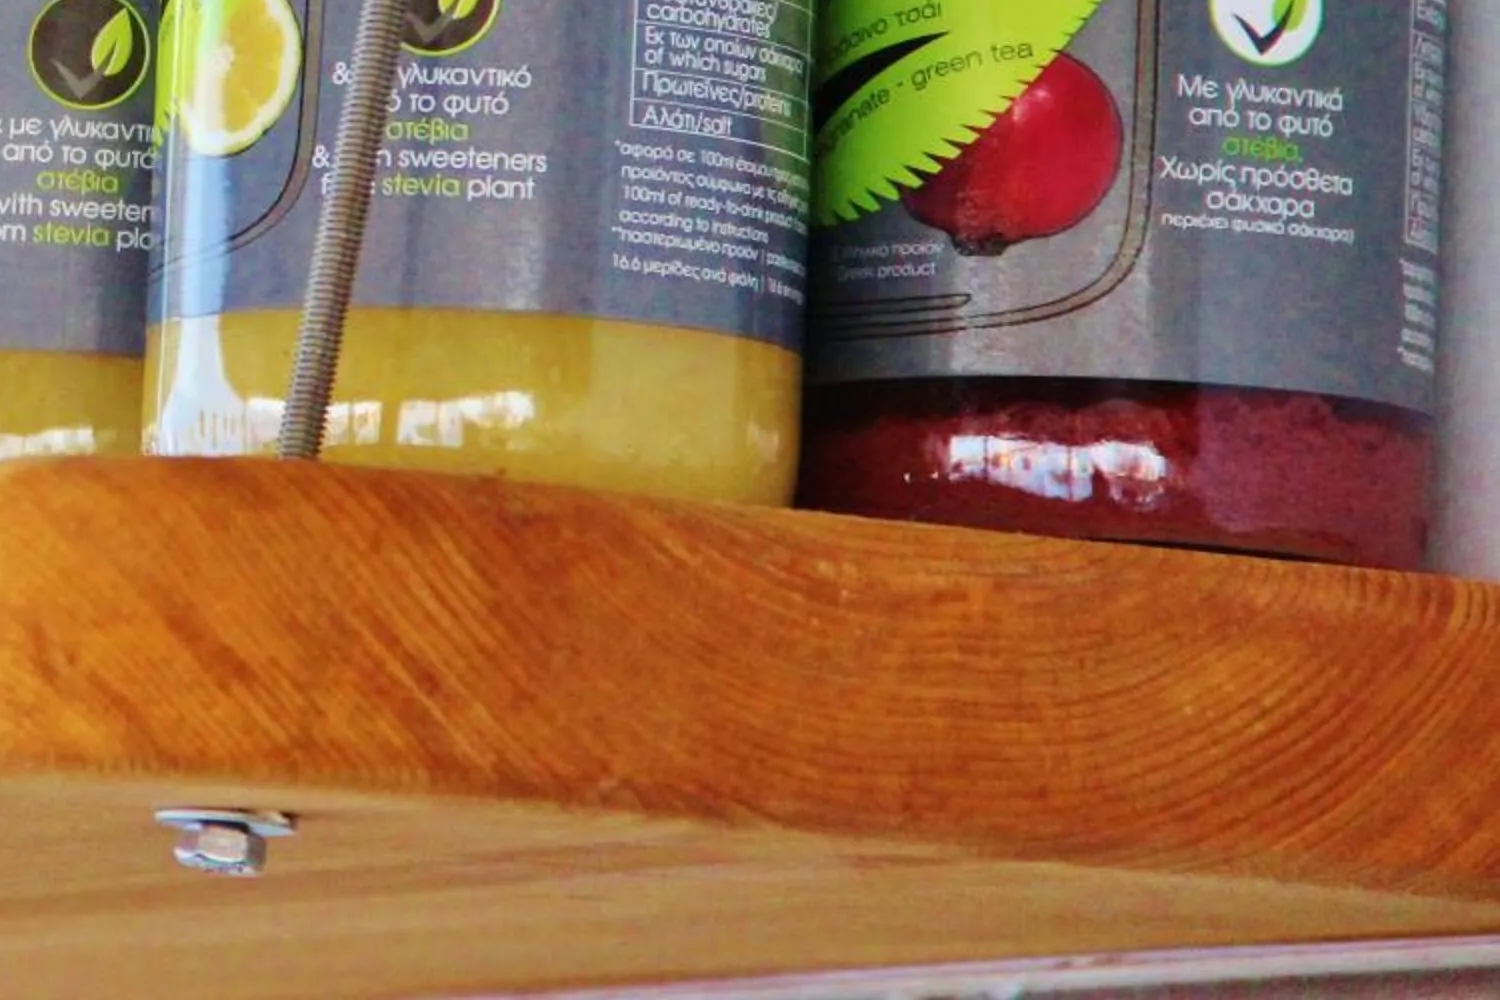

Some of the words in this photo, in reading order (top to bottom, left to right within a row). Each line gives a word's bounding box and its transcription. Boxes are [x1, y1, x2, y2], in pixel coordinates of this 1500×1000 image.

[646, 3, 770, 39] carbohydrates
[644, 48, 664, 66] of
[669, 52, 721, 73] which
[911, 48, 984, 92] green
[991, 40, 1034, 62] tea
[398, 62, 532, 89] γλυκαντικό
[408, 92, 436, 114] το
[442, 91, 510, 117] φυτό
[1176, 72, 1219, 101] Με
[1226, 76, 1344, 112] γλυκαντικά
[9, 115, 43, 139] με
[385, 118, 469, 146] στέβια
[1188, 103, 1241, 129] από
[1247, 110, 1273, 132] το
[1277, 113, 1335, 140] φυτό
[2, 140, 54, 164] από
[62, 144, 87, 166] το
[399, 146, 548, 174] sweeteners
[36, 166, 119, 194] στέβια
[381, 174, 461, 198] stevia
[466, 174, 536, 201] plant
[1159, 154, 1238, 191] Χωρίς
[1240, 164, 1354, 197] πρόσθετα
[1206, 188, 1316, 220] σάκχαρα
[33, 222, 110, 247] stevia
[618, 210, 694, 233] according
[696, 216, 710, 233] to
